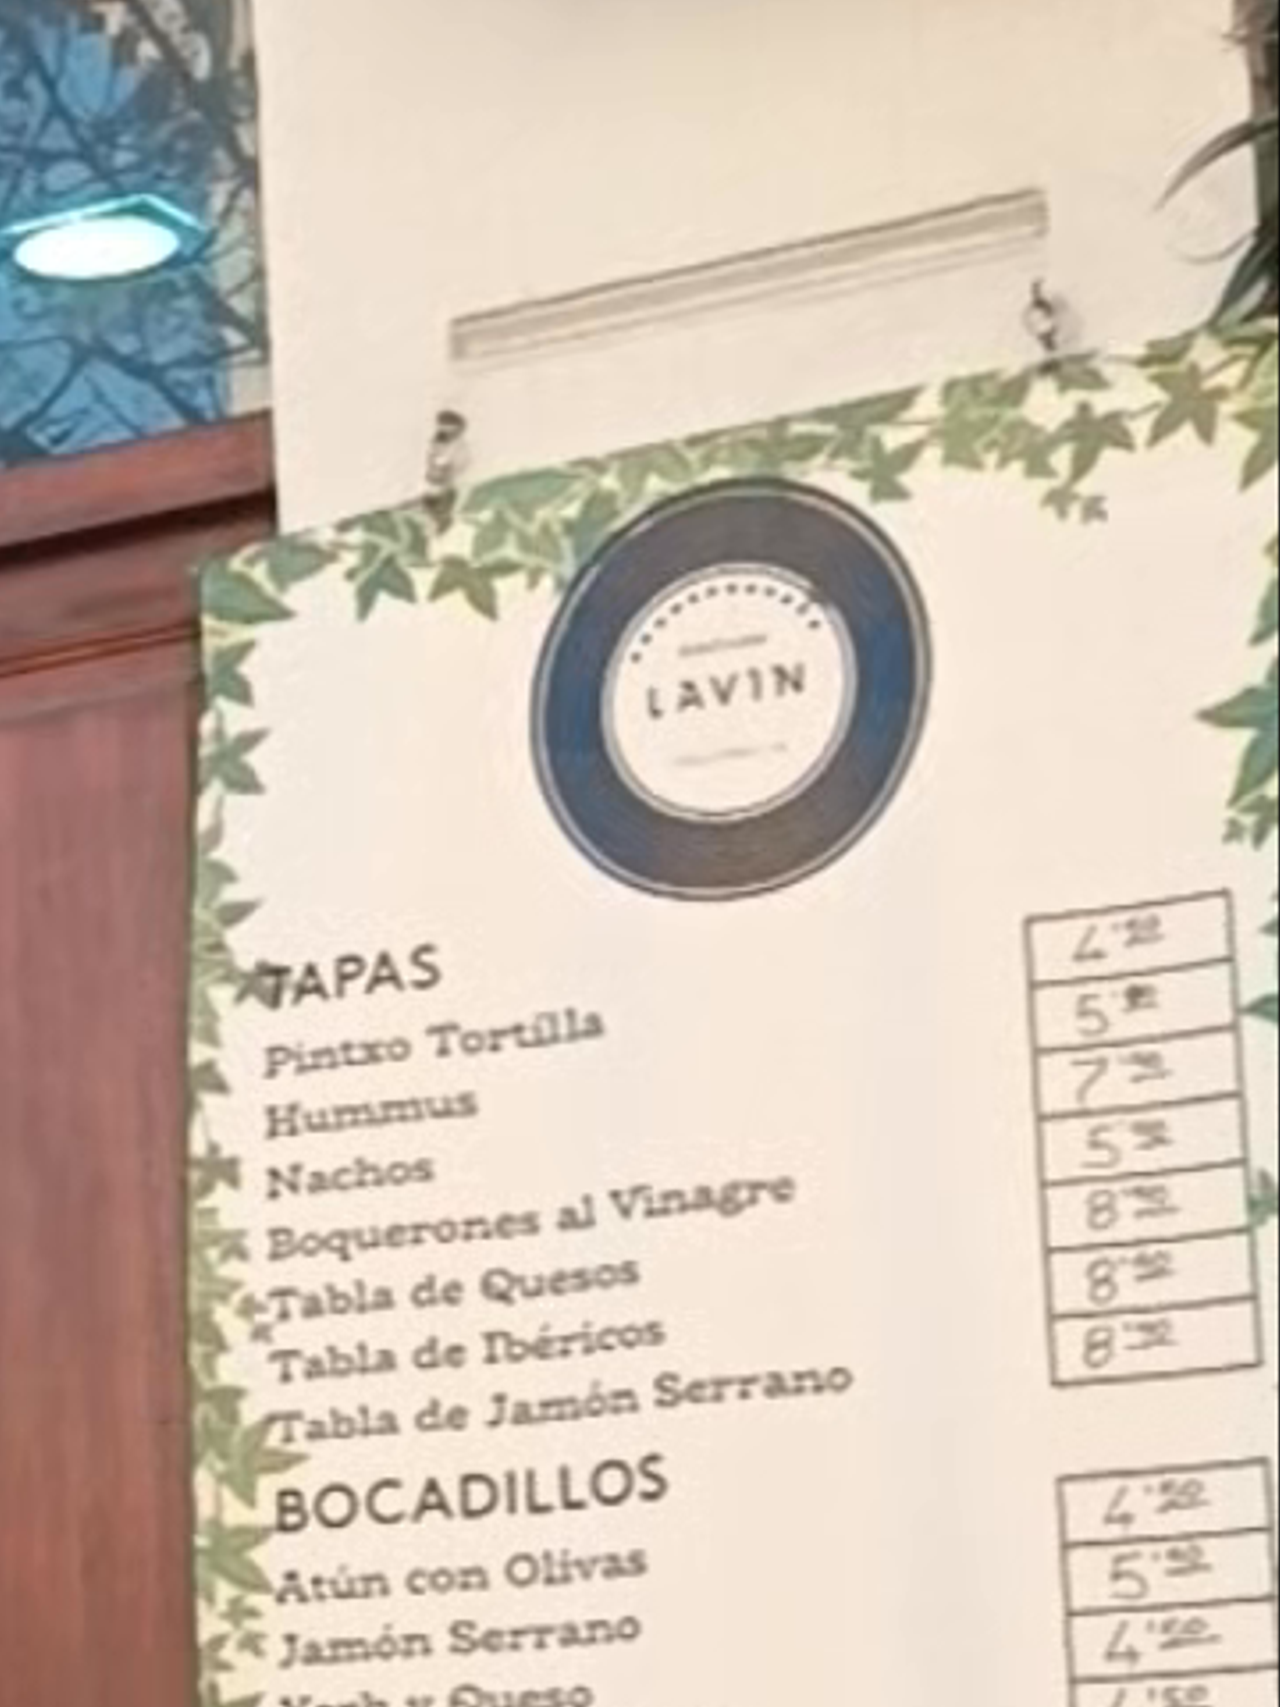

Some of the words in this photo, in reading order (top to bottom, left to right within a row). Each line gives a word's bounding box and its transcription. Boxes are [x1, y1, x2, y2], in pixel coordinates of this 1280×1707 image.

[646, 661, 806, 720] LAVIN
[255, 943, 442, 1010] TAPAS
[262, 1035, 413, 1081] Pintxo
[424, 1007, 607, 1060] Tortilla
[263, 1090, 481, 1142] Hummus
[264, 1155, 437, 1203] Nachos
[265, 1209, 543, 1264] Boquerones
[554, 1192, 598, 1233] al
[606, 1174, 797, 1222] Vinagre
[264, 1277, 397, 1325] Tabla
[408, 1272, 466, 1310] de
[478, 1258, 642, 1308] Quesos
[266, 1340, 399, 1386] Tabla
[410, 1334, 468, 1372] de
[480, 1319, 668, 1367] Ibéricos
[269, 1403, 401, 1446] Tabla
[412, 1396, 471, 1434] de
[483, 1379, 642, 1431] Jamón
[651, 1365, 855, 1410] Serrano
[274, 1453, 670, 1534] BOCADILLOS
[273, 1564, 393, 1607] Atún
[403, 1564, 492, 1597] con
[502, 1547, 650, 1590] Olivas
[276, 1622, 435, 1671] Jamón
[446, 1614, 643, 1657] Serrano
